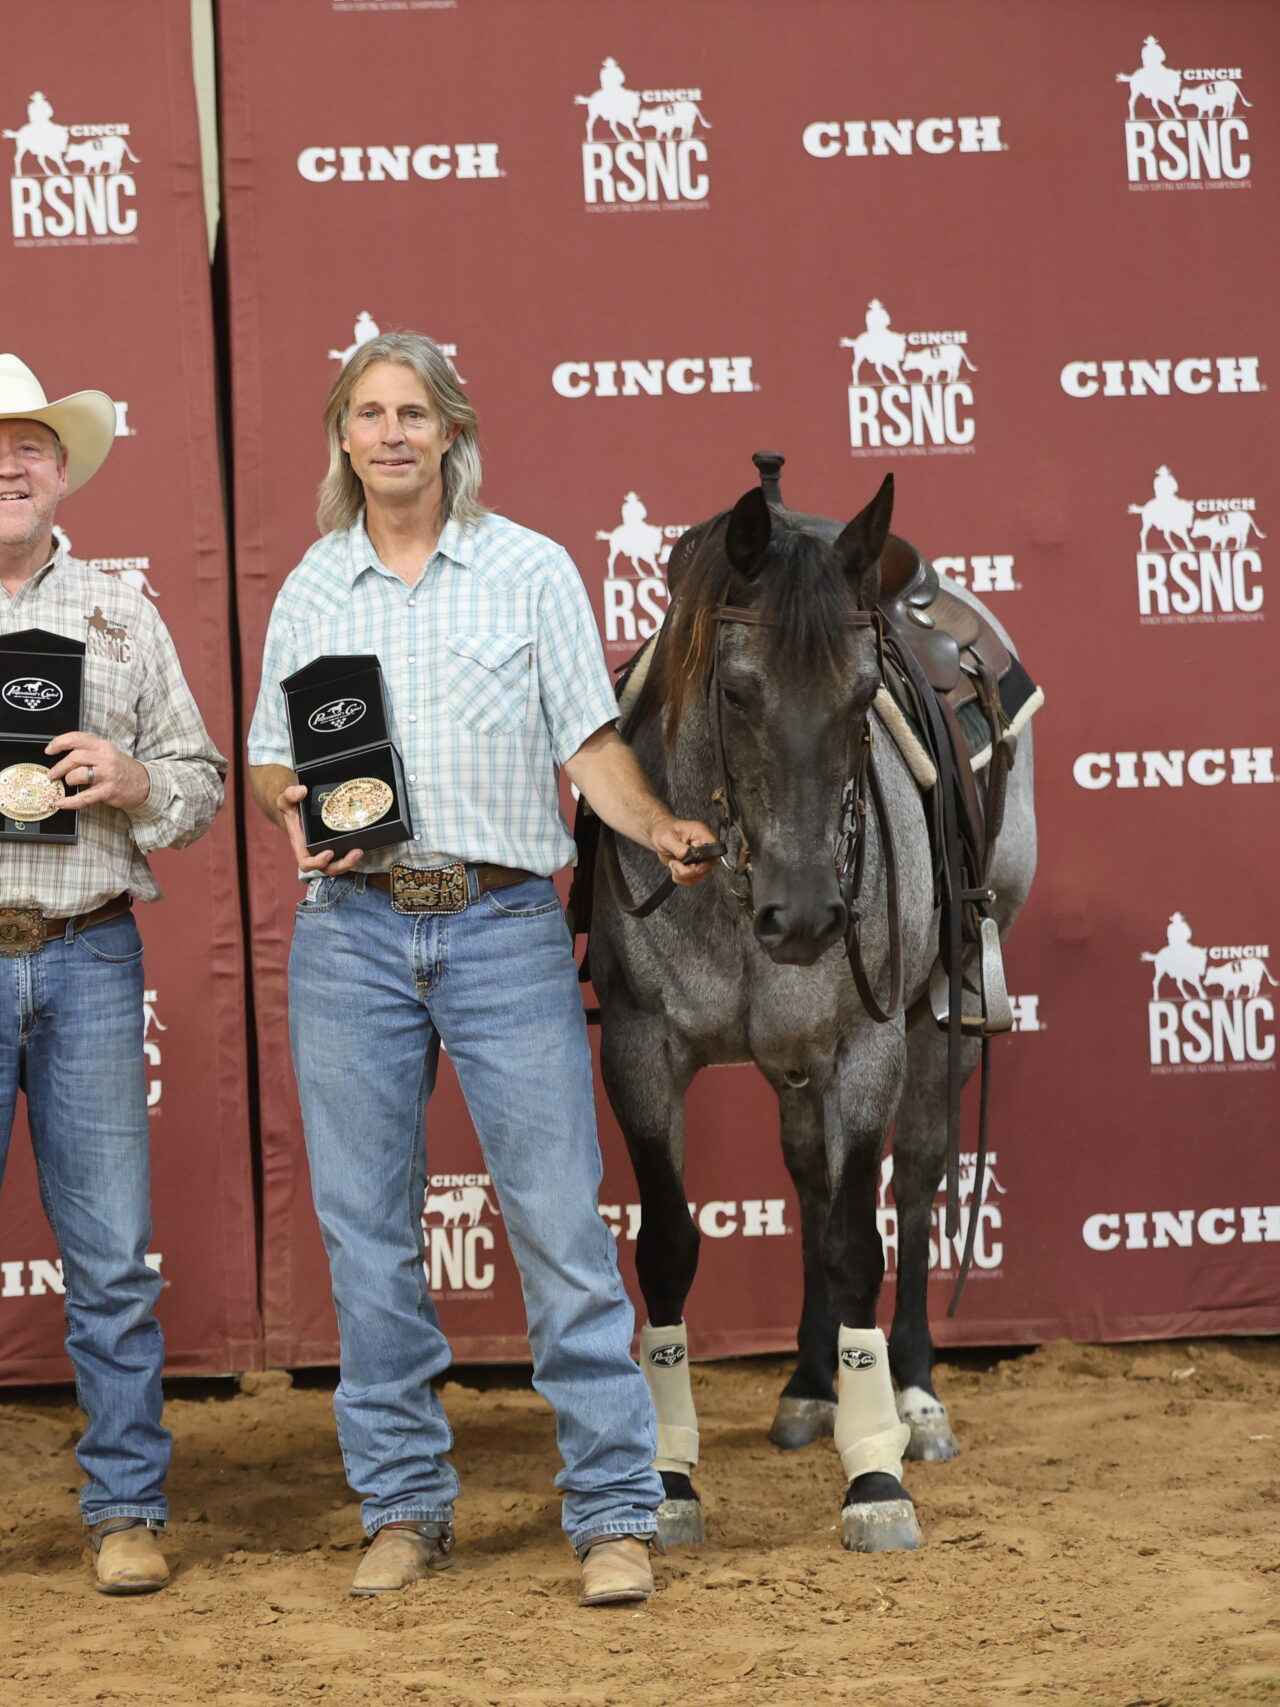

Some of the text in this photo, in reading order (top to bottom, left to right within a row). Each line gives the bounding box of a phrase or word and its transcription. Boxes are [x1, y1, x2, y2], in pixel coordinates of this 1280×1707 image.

[641, 88, 703, 102] CINCH
[1182, 68, 1243, 81] CINCH
[69, 123, 131, 137] CINCH
[802, 116, 1002, 158] CINCH
[1124, 119, 1251, 182] RSNC
[297, 143, 497, 183] CINCH
[583, 140, 710, 203] RSNC
[11, 175, 138, 238] RSNC
[906, 331, 968, 345] CINCH
[551, 356, 750, 399] CINCH
[1060, 356, 1260, 398] CINCH
[847, 382, 975, 447] RSNC
[1195, 498, 1257, 512] CINCH
[1137, 550, 1264, 615] RSNC
[604, 577, 676, 642] RS
[86, 634, 131, 663] RSNC
[1072, 747, 1274, 790] CINCH
[405, 872, 452, 881] RANCH
[1213, 945, 1275, 959] CINCH
[1148, 998, 1277, 1064] RSNC
[430, 1173, 491, 1188] CINCH
[599, 1199, 786, 1241] CICH
[1082, 1205, 1280, 1251] CINCH
[423, 1226, 495, 1291] NC
